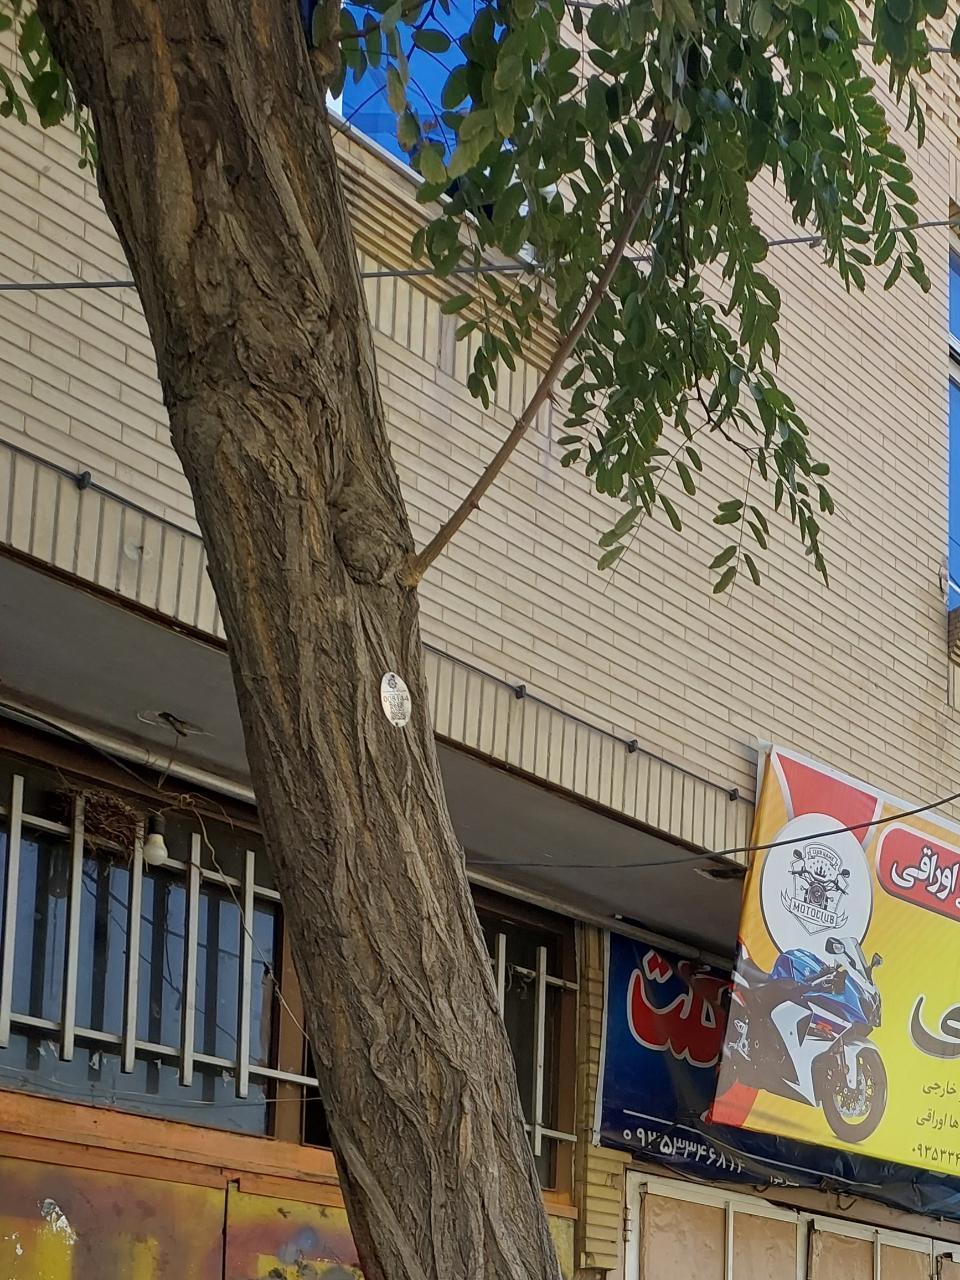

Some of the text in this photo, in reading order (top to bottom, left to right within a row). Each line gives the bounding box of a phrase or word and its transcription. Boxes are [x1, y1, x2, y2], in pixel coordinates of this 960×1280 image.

[890, 846, 960, 901] اوراقی
[793, 902, 835, 925] MOTOCLUB
[922, 1080, 957, 1098] خارجی
[916, 1108, 947, 1130] اوراقی
[949, 1114, 959, 1129] ها
